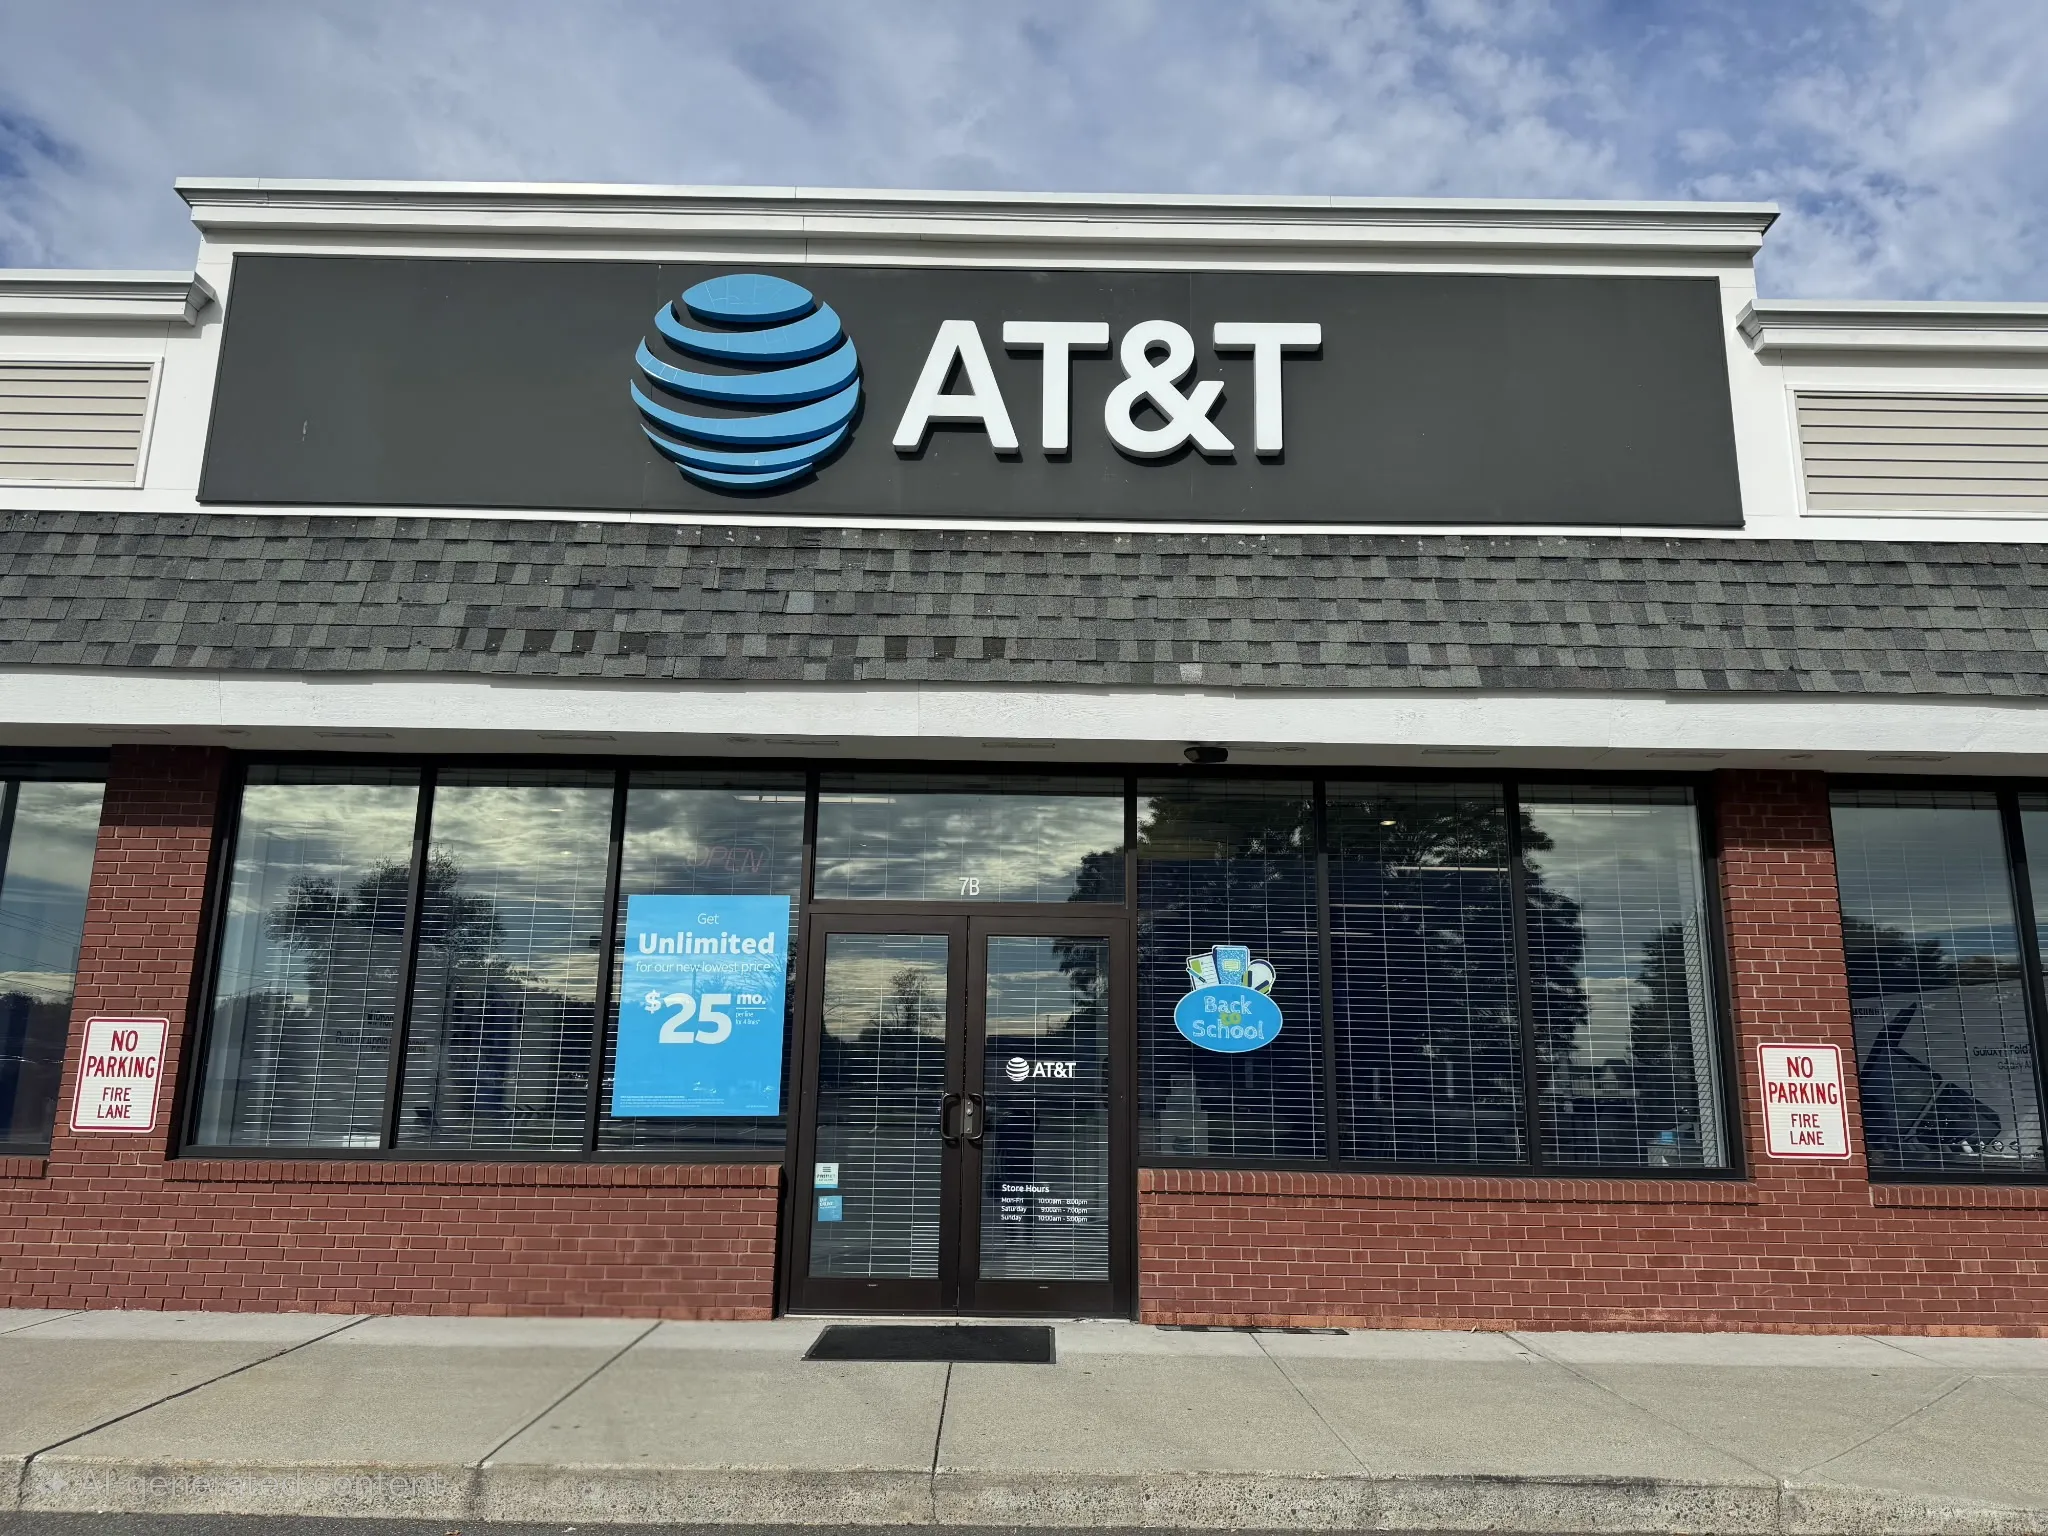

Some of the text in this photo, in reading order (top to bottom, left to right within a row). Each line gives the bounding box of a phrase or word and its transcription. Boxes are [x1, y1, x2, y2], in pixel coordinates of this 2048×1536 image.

[892, 319, 1322, 458] AT&T
[686, 845, 764, 873] OPEN
[959, 876, 980, 896] 7B
[697, 913, 719, 925] Get
[639, 931, 775, 954] Unlimited
[636, 961, 651, 972] for
[654, 963, 674, 972] our
[676, 963, 700, 972] new
[702, 962, 738, 972] lowest
[1203, 995, 1253, 1015] Back
[644, 989, 766, 1045] $25 mo.
[1192, 1019, 1265, 1040] School
[111, 1030, 139, 1052] NO
[86, 1055, 156, 1078] PARKING
[1033, 1062, 1077, 1078] AT&T
[1786, 1056, 1813, 1079] NO
[102, 1087, 132, 1102] FIRE
[1768, 1082, 1838, 1105] PARKING
[97, 1104, 132, 1119] LANE
[1791, 1113, 1820, 1129] FIRE
[1790, 1131, 1825, 1146] LANE
[1002, 1184, 1050, 1193] Store Hours
[1001, 1214, 1022, 1222] Sunday
